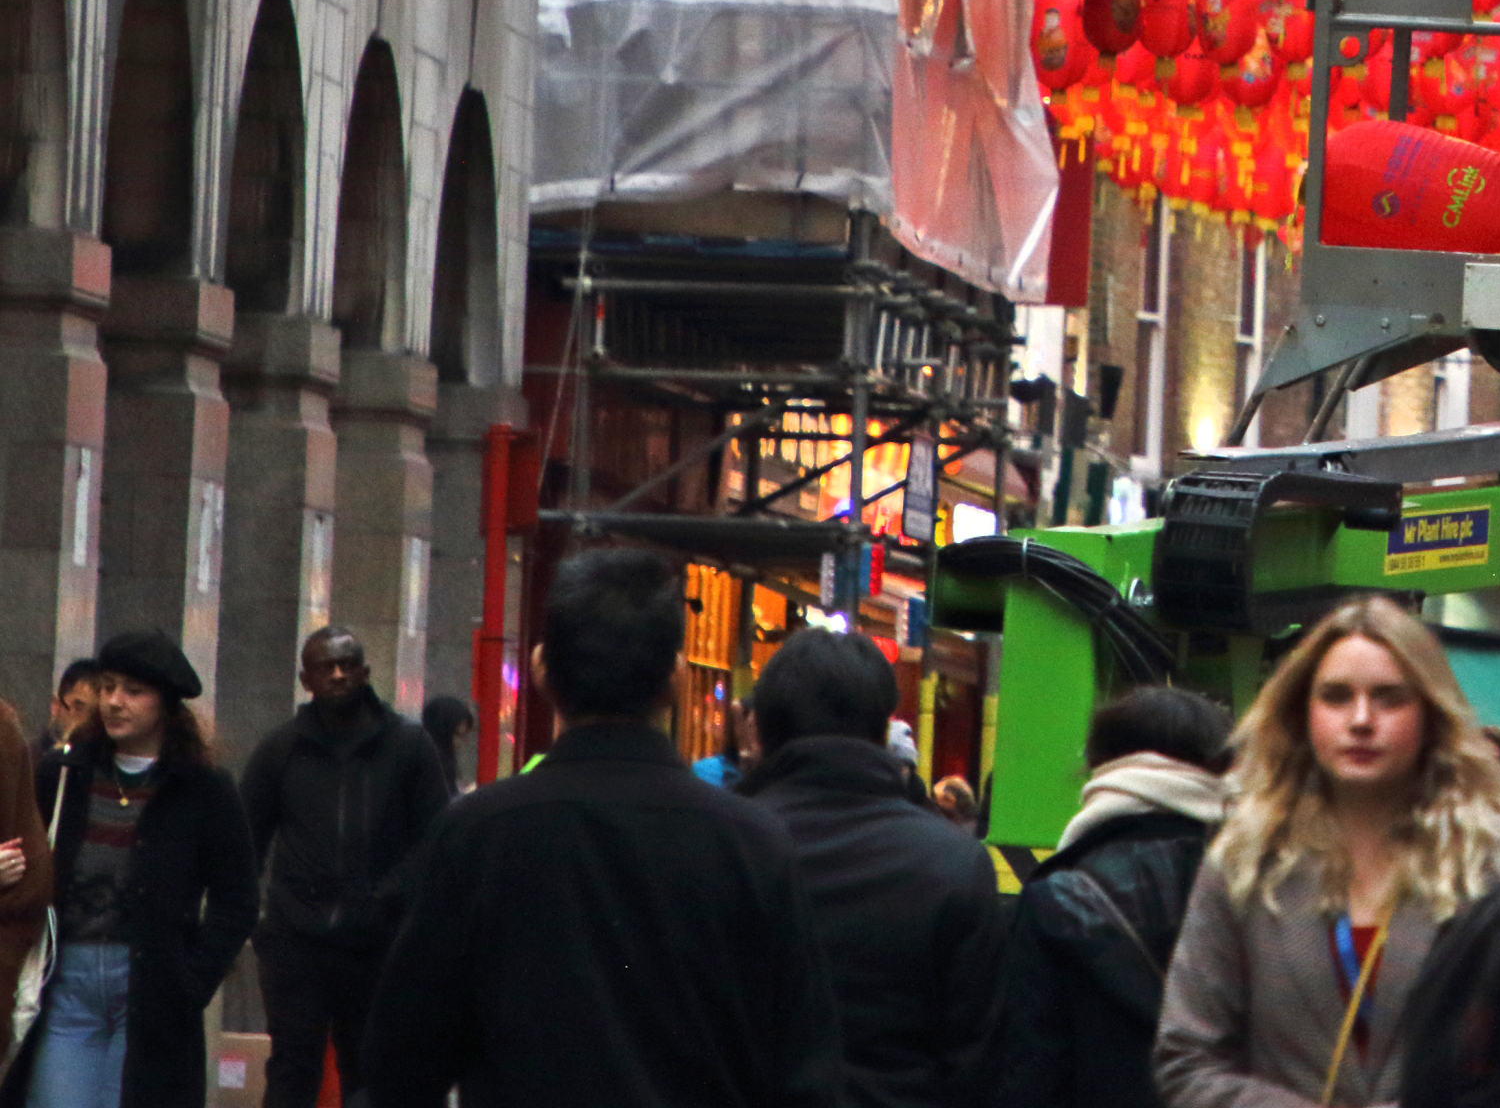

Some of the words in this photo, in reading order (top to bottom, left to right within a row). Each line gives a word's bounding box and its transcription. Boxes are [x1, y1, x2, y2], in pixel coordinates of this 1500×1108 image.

[1442, 165, 1481, 228] CMLink
[1418, 518, 1440, 543] Plant
[1441, 515, 1459, 541] Hire
[1459, 514, 1474, 546] plc
